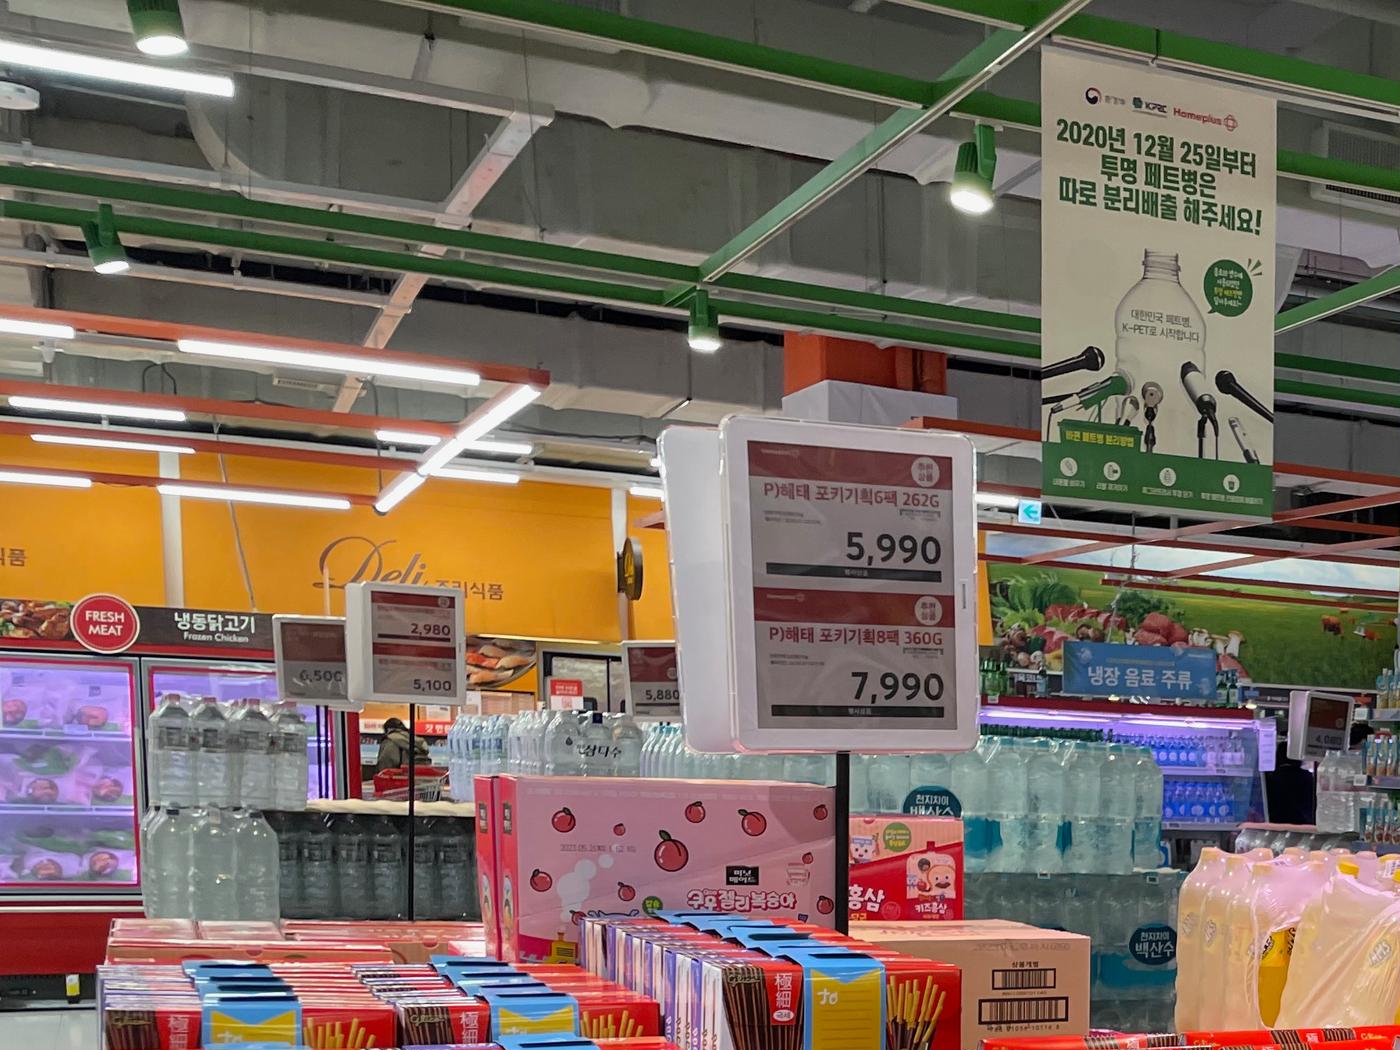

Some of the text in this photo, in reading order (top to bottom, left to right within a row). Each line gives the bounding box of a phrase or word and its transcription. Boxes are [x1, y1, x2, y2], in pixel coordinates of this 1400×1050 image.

[1173, 107, 1222, 126] Homeplus
[1057, 119, 1256, 178] 2020년 12월 25일부터
[1101, 154, 1217, 199] 투명 페트병은
[1059, 176, 1262, 235] 따로 분리배출 해주세요!
[1131, 309, 1163, 323] 대한민국
[1122, 323, 1200, 344] K-PET로 시작합니다
[764, 482, 940, 508] P)해태 포키기획6팩 262G
[0, 548, 26, 567] 품
[847, 531, 941, 566] 5,990
[312, 536, 427, 588] Deli
[85, 610, 124, 623] FRESH
[174, 611, 255, 633] 냉동닭고기
[88, 624, 123, 636] MEAT
[184, 632, 249, 643] Frozen Chicken
[411, 624, 450, 637] 2,980
[769, 626, 943, 646] P)해태 포키기획8팩 360G
[413, 680, 451, 692] 5,100
[851, 672, 944, 704] 7,990
[1088, 666, 1193, 690] 냉장 음료 주류
[646, 690, 679, 701] 5,880
[849, 884, 885, 912] 홍삼
[1135, 941, 1175, 958] 백산수
[774, 971, 793, 1008] 極細
